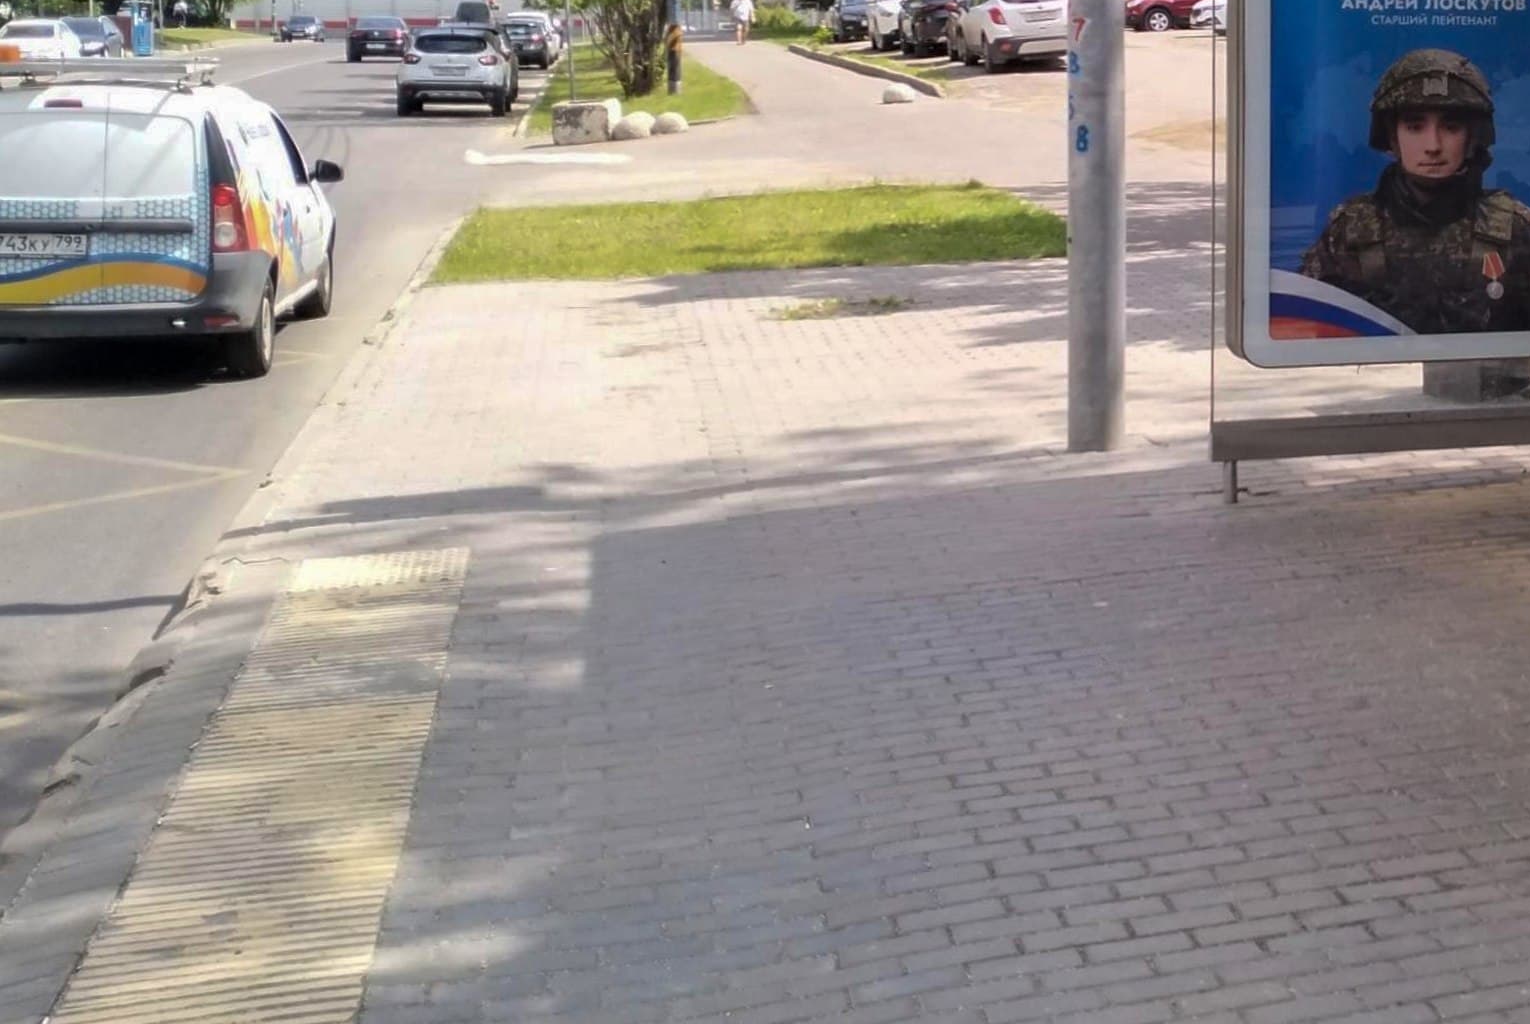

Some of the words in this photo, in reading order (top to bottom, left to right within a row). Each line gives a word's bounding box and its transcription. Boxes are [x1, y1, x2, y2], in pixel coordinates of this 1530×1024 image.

[1371, 12, 1428, 26] СТАРШИЙ
[1431, 13, 1498, 26] ЛЕЙТЕНАНТ
[55, 235, 82, 249] 799
